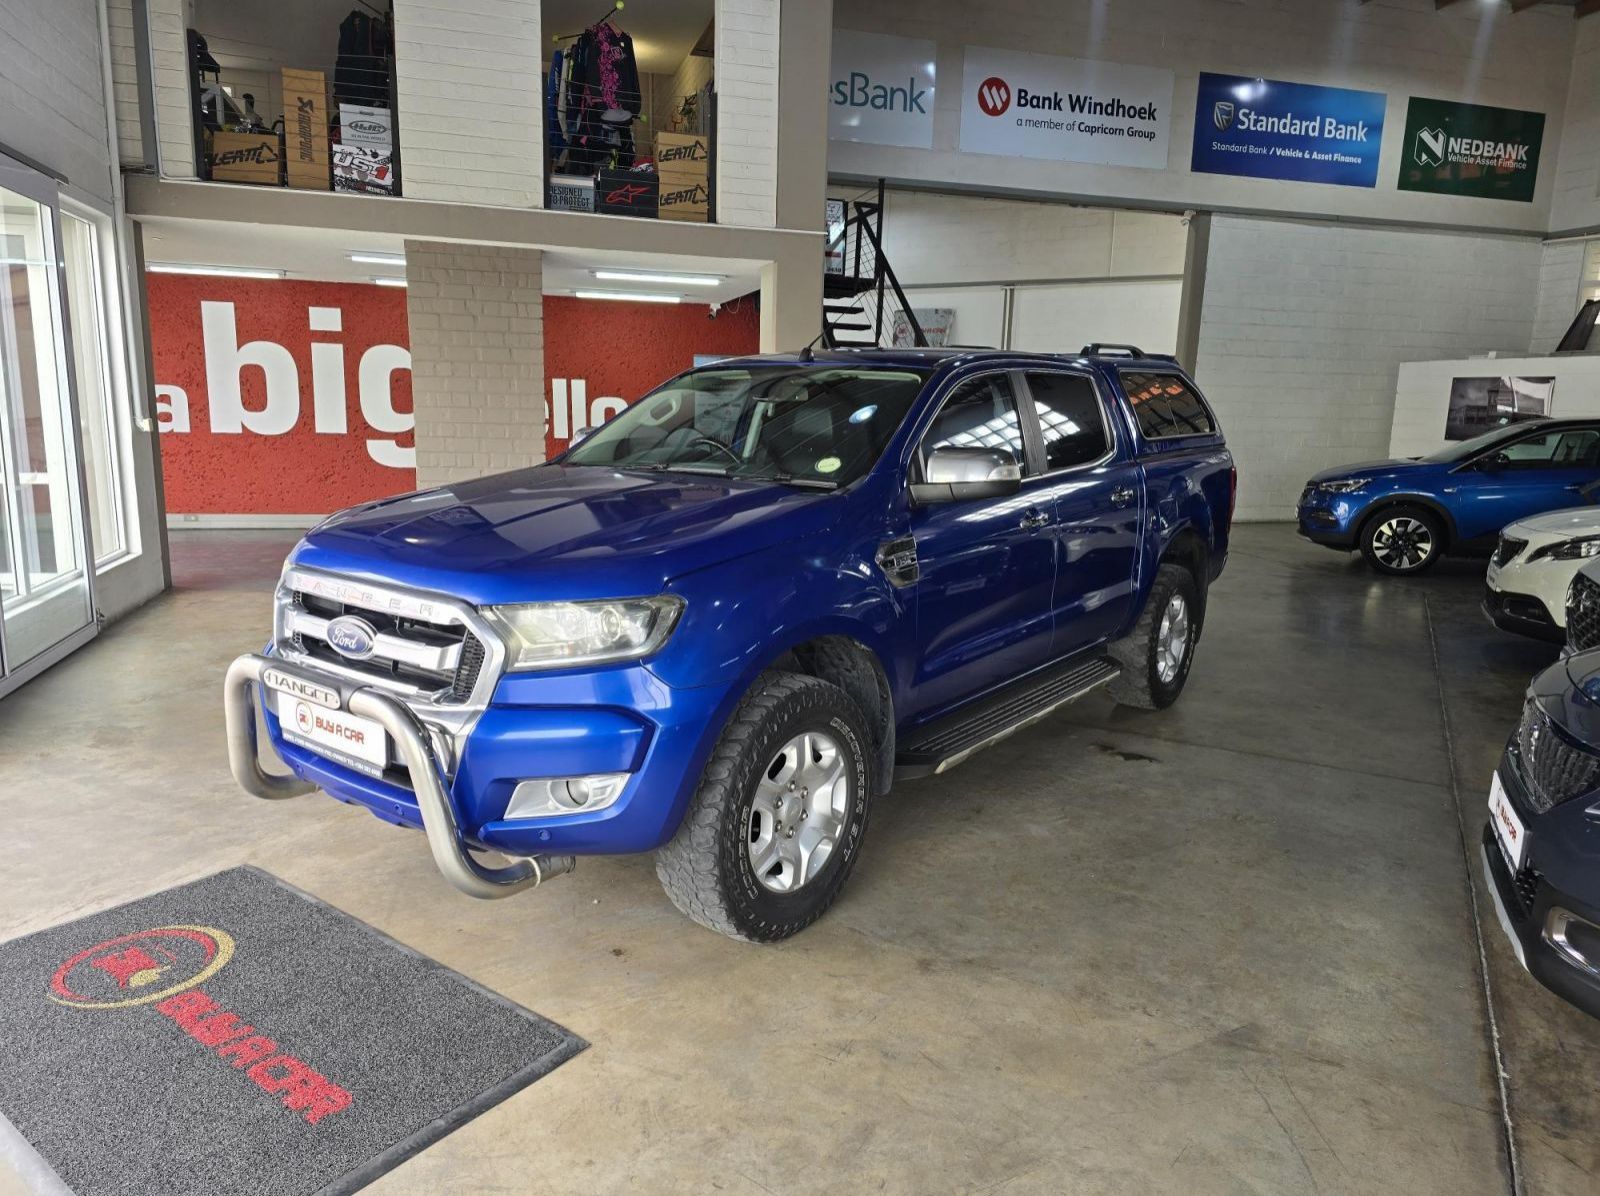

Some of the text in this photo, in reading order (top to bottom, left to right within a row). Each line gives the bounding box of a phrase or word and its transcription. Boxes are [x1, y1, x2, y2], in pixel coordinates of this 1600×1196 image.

[830, 71, 926, 114] sBank
[1017, 88, 1157, 121] Bank Windhoek
[1016, 118, 1156, 141] a member of Capricorn Group
[1237, 108, 1368, 142] Standard Bank
[1212, 141, 1248, 153] Standard
[1249, 144, 1268, 155] Bank
[1275, 148, 1303, 158] Vehicle
[1312, 151, 1333, 161] Asset
[1333, 153, 1362, 164] Finance
[1447, 137, 1530, 161] NEDBANK
[1447, 153, 1527, 169] Vehicle Asset Finance
[201, 301, 416, 468] big
[545, 378, 628, 439] llo
[332, 626, 359, 649] Ford
[315, 715, 365, 744] BUY A CAR
